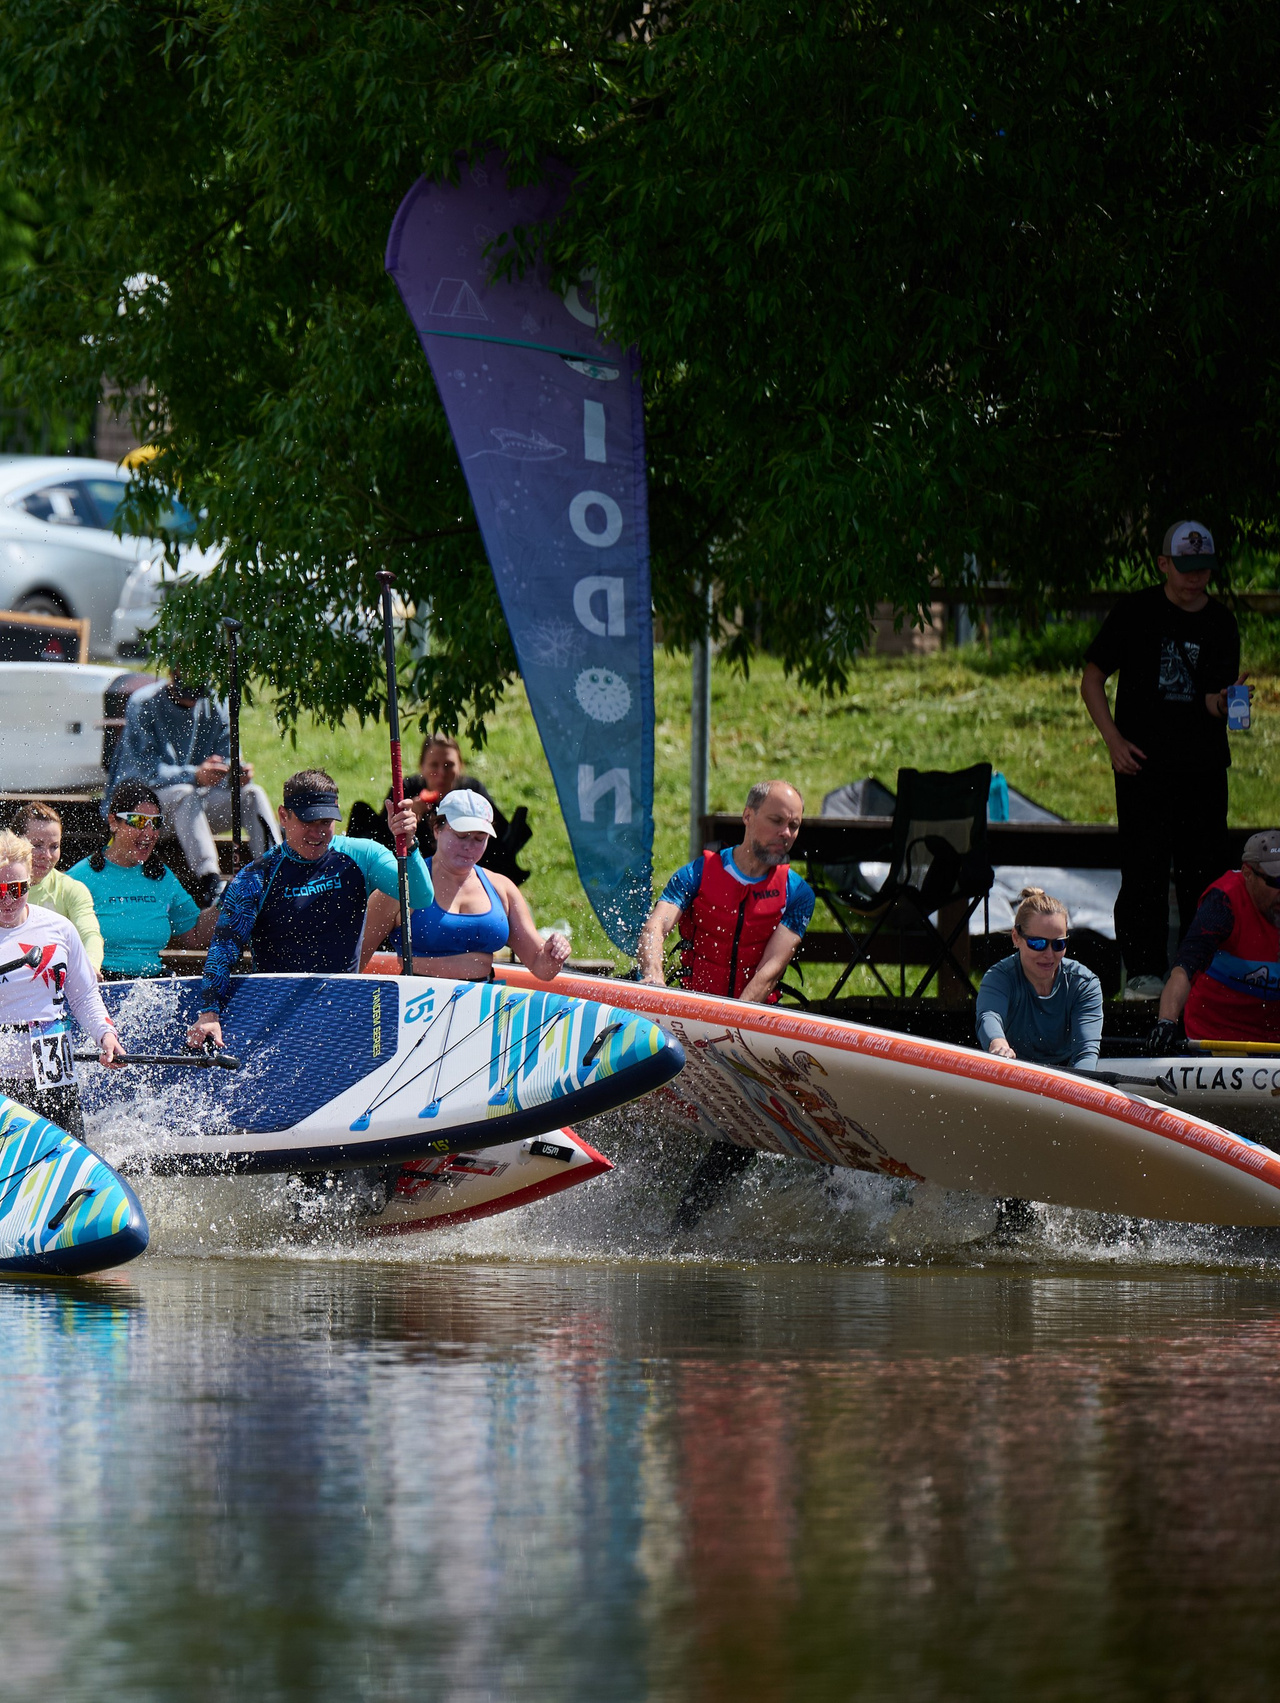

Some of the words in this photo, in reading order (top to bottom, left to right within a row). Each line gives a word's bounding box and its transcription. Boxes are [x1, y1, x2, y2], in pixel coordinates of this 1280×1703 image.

[752, 889, 780, 900] hike
[372, 987, 381, 1026] TANDEM
[372, 1026, 381, 1058] SERIES
[1165, 1066, 1244, 1090] ATLAS
[541, 1144, 560, 1155] USM
